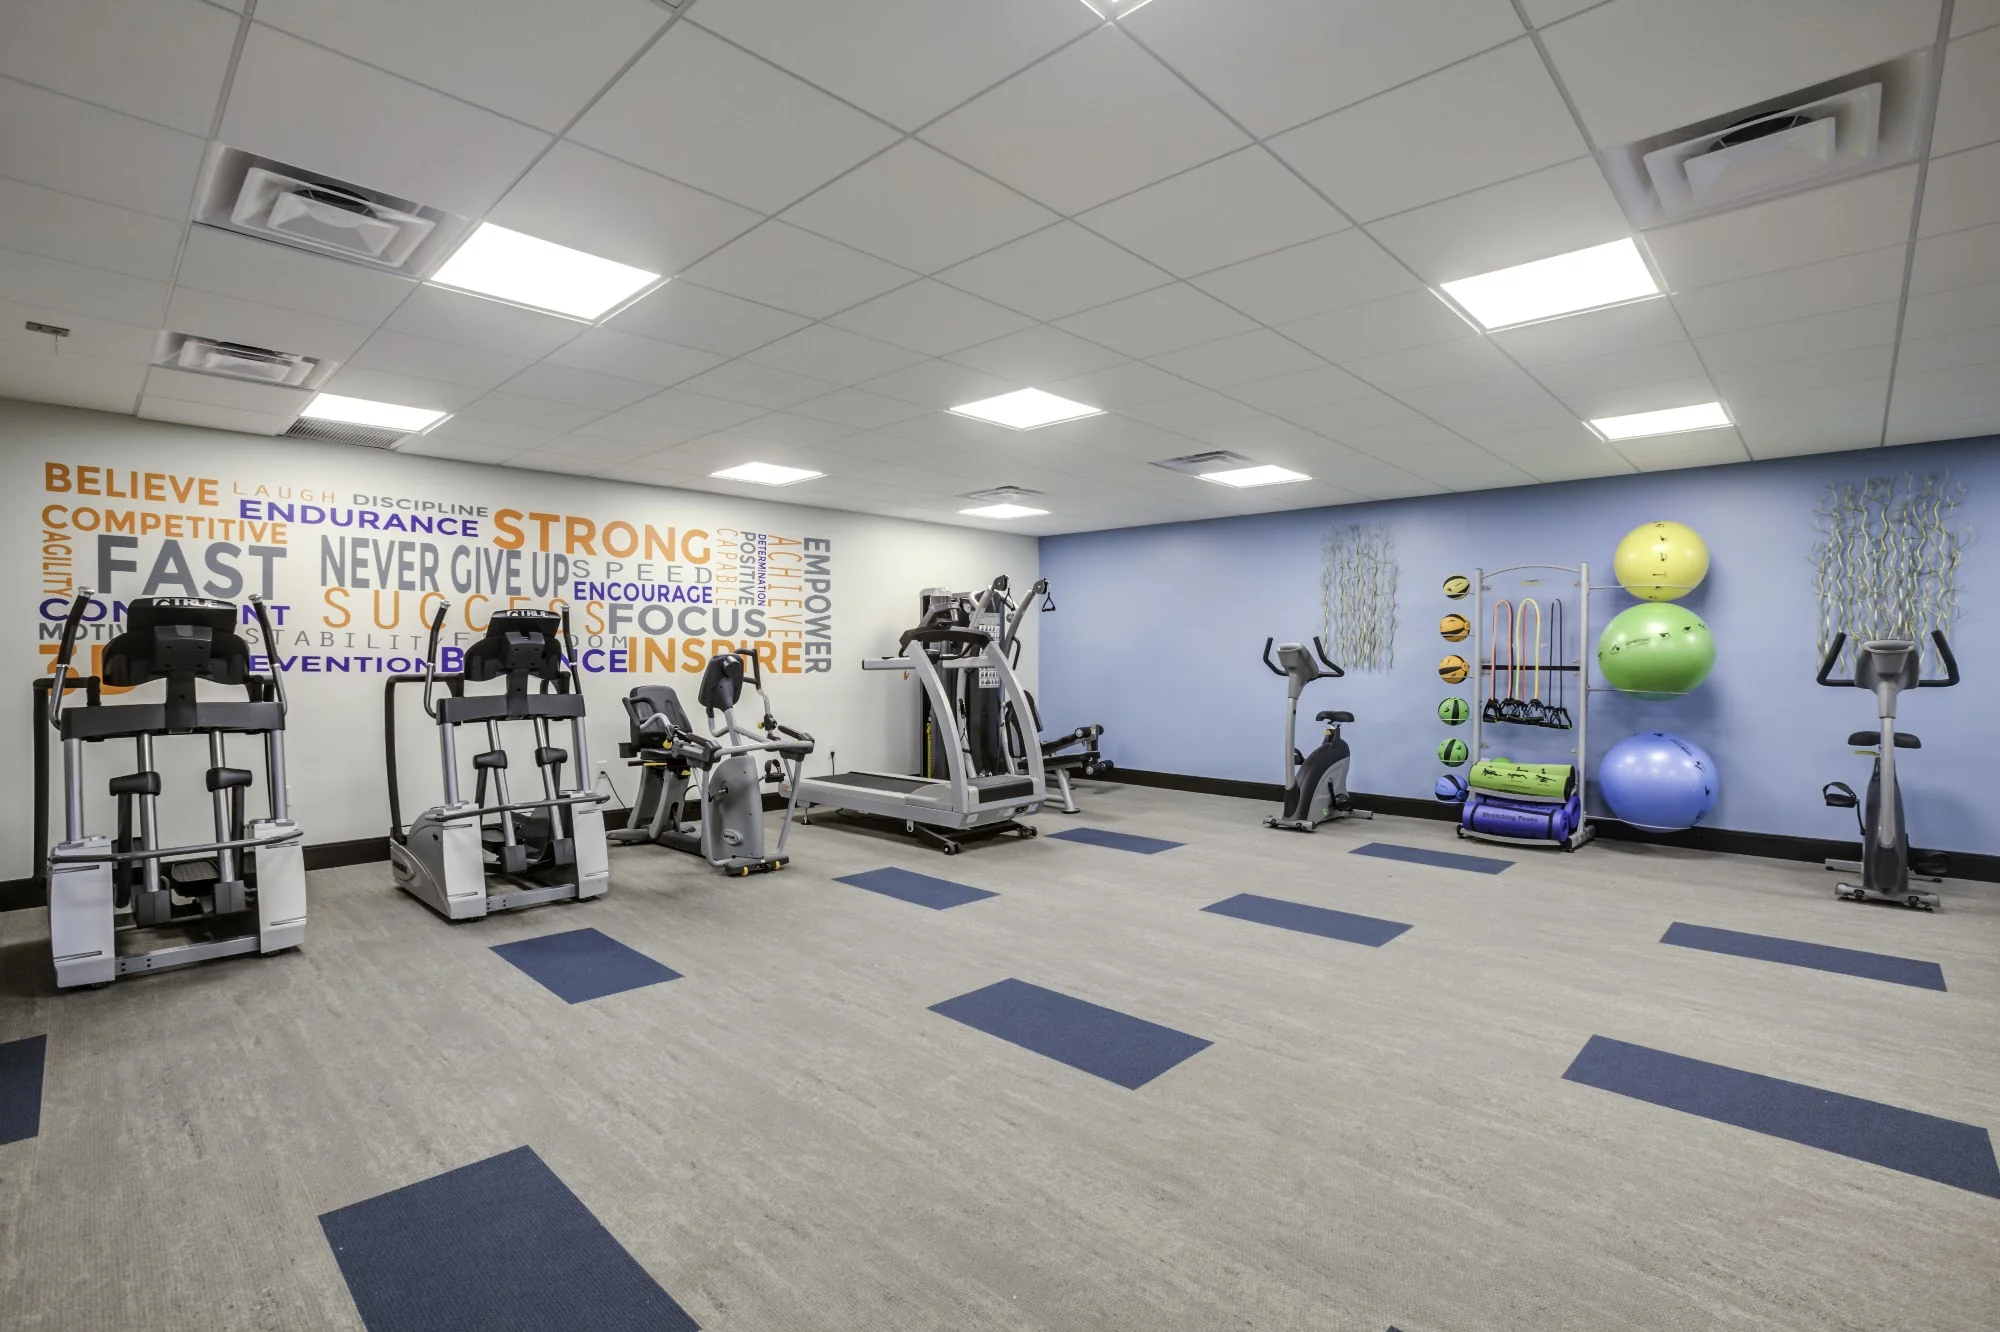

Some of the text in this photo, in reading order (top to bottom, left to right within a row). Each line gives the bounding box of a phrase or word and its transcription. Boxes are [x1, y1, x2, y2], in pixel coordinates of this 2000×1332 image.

[45, 462, 219, 506] BELIEVE
[233, 481, 335, 503] LAUGH
[42, 504, 288, 544] COMPETITIVE
[240, 499, 478, 537] ENDURANCE
[353, 494, 488, 517] DISCIPLINE
[493, 509, 711, 564] STRONG
[42, 530, 72, 598] AGILITY
[98, 534, 287, 600] FAST
[321, 534, 570, 598] NEVER GIVE UP
[572, 559, 712, 584] SPEED
[715, 528, 738, 606] CAPABLE
[739, 531, 756, 606] POSITIVE
[758, 534, 767, 607] DETERMINATION
[171, 597, 218, 607] TRUE
[574, 581, 713, 603] ENCOURAGE
[768, 534, 802, 639] ACHIEVE
[804, 537, 832, 674] EMPOWER
[520, 609, 549, 617] TRUE
[608, 603, 767, 637] FOCUS
[246, 628, 444, 651] STABILIT
[248, 654, 437, 673] EVENTION
[1482, 811, 1516, 822] Stretching
